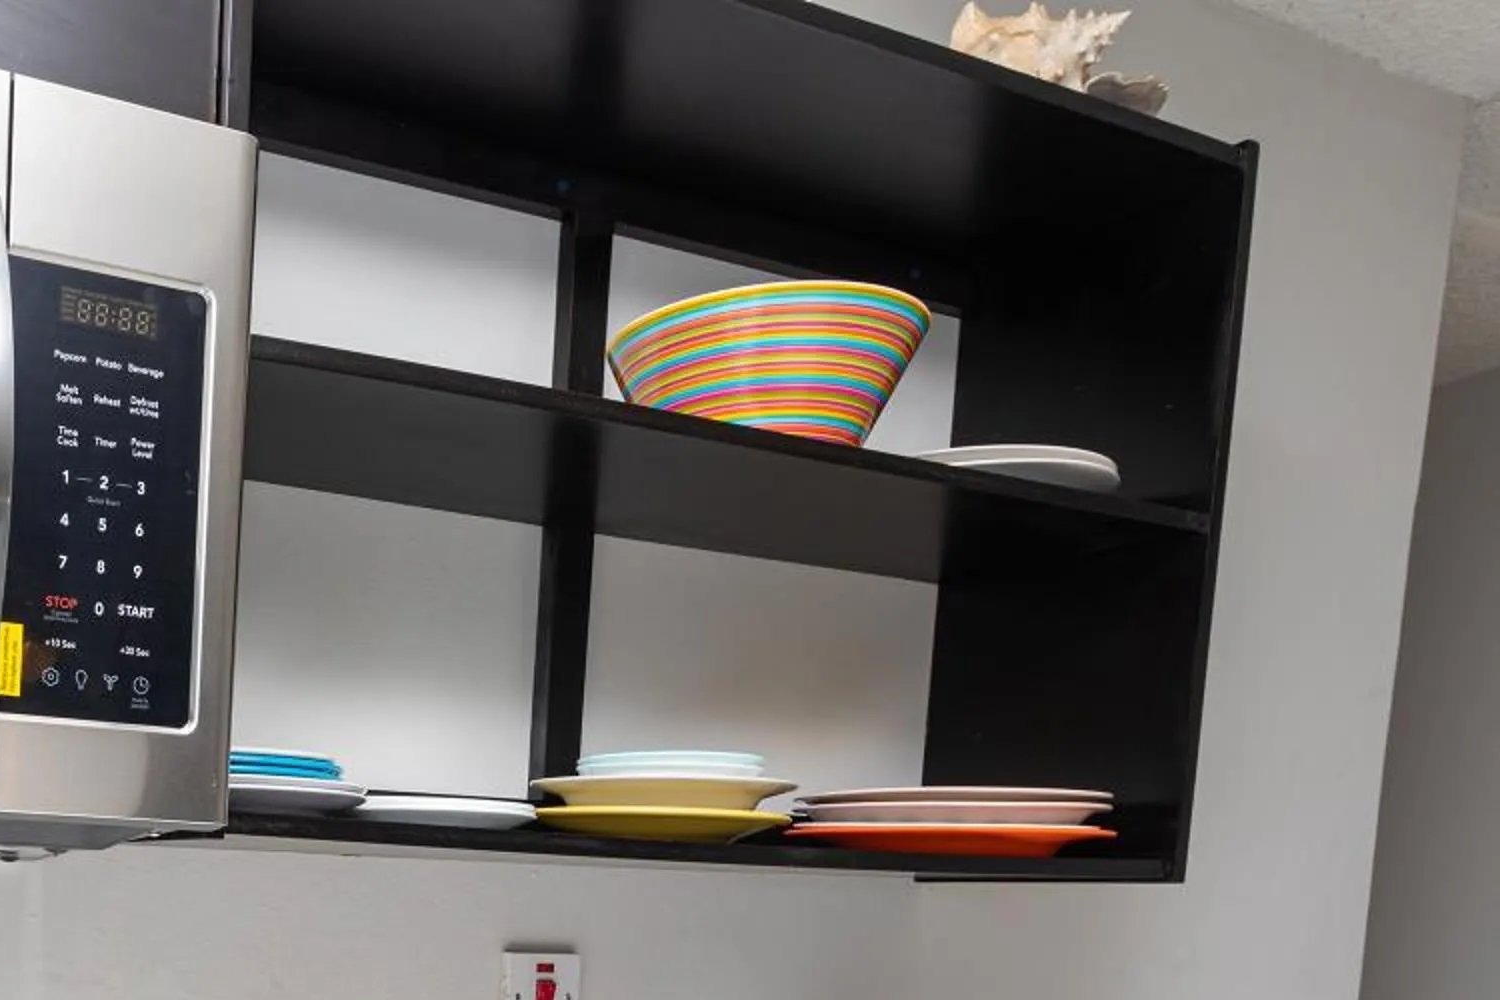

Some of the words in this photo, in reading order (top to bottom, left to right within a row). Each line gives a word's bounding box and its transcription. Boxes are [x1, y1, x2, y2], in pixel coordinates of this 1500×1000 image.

[54, 349, 87, 363] Popcorn
[95, 356, 123, 371] Potato
[128, 363, 165, 379] Beverage
[93, 393, 122, 408] Reheat
[130, 396, 159, 409] Defrost
[57, 425, 79, 438] Time
[56, 436, 79, 449] Cook
[94, 436, 118, 449] Timer
[130, 436, 156, 450] Power
[131, 448, 154, 461] Level
[62, 469, 70, 485] 1
[99, 475, 109, 491] 2
[136, 480, 146, 496] 3
[59, 512, 70, 527] 4
[97, 517, 108, 532] 5
[135, 523, 145, 538] 6
[58, 554, 69, 570] 7
[96, 559, 106, 575] 8
[133, 564, 143, 580] 9
[45, 595, 78, 609] STOP
[94, 601, 105, 616] 0
[117, 604, 155, 618] START
